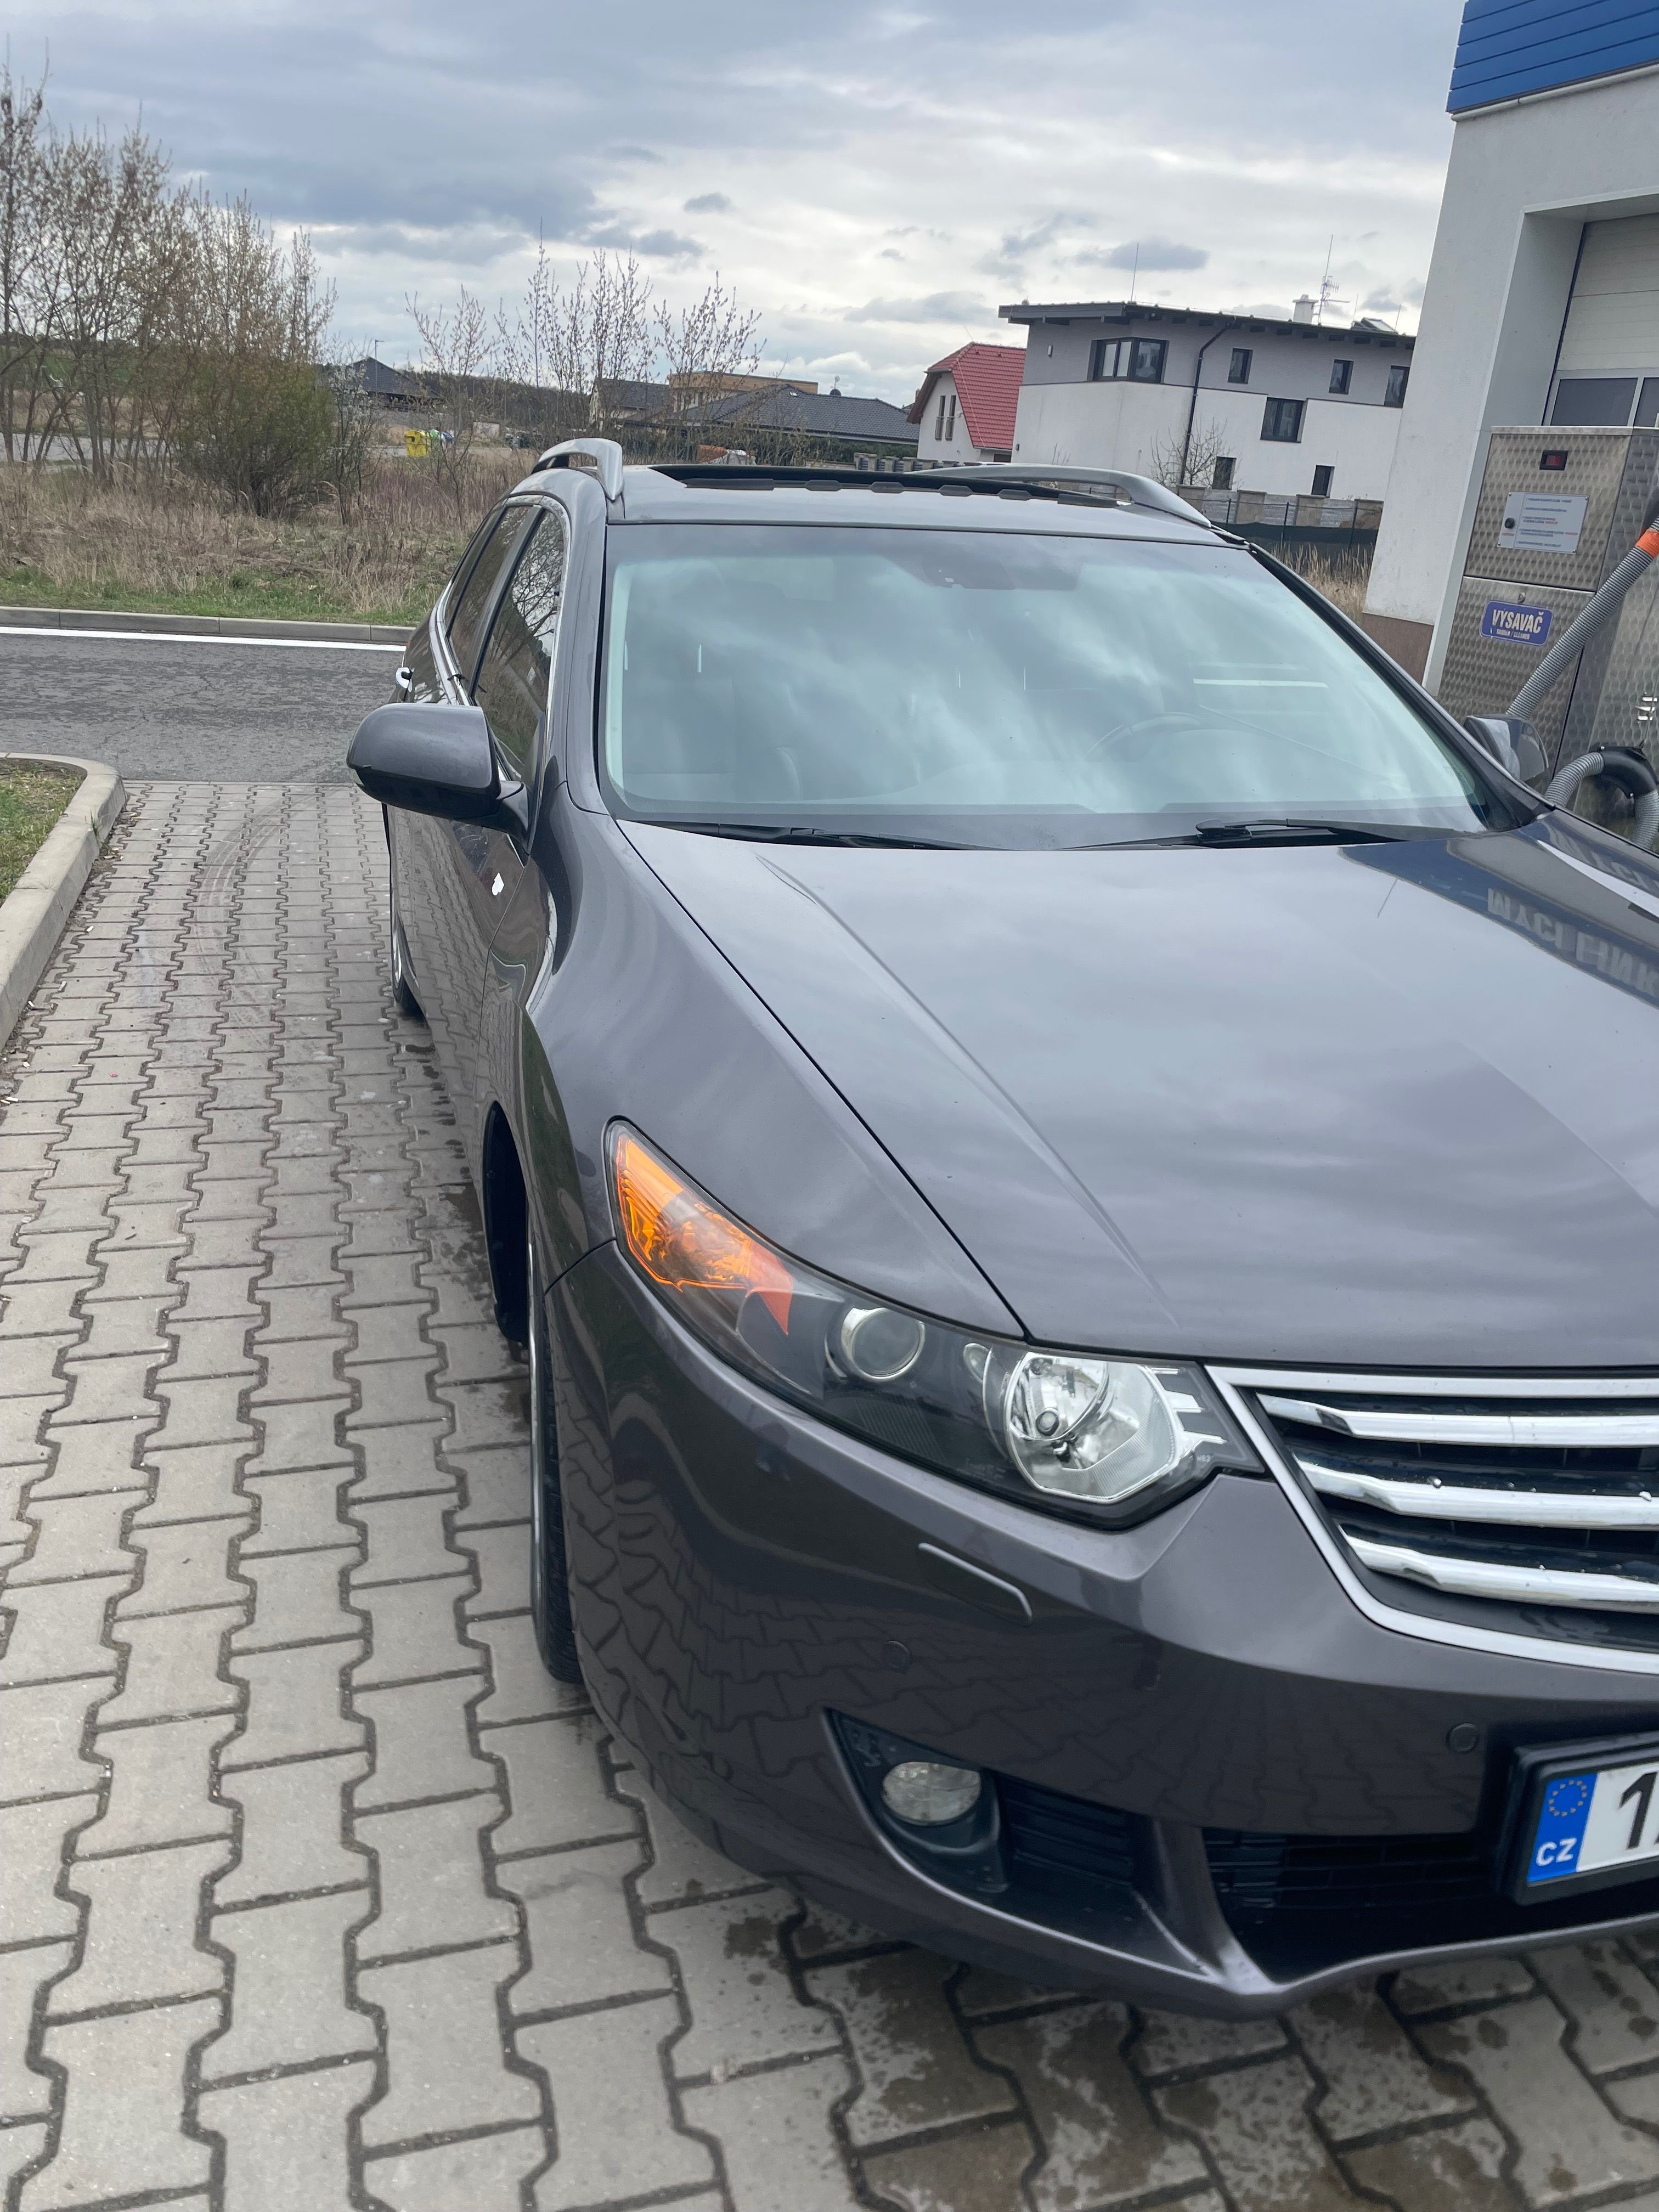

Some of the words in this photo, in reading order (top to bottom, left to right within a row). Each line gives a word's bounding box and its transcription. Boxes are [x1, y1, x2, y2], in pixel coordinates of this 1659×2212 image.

[1492, 610, 1544, 634] VYSAVAČ
[1619, 1771, 1659, 1850] 1
[1536, 1838, 1577, 1866] CZ
